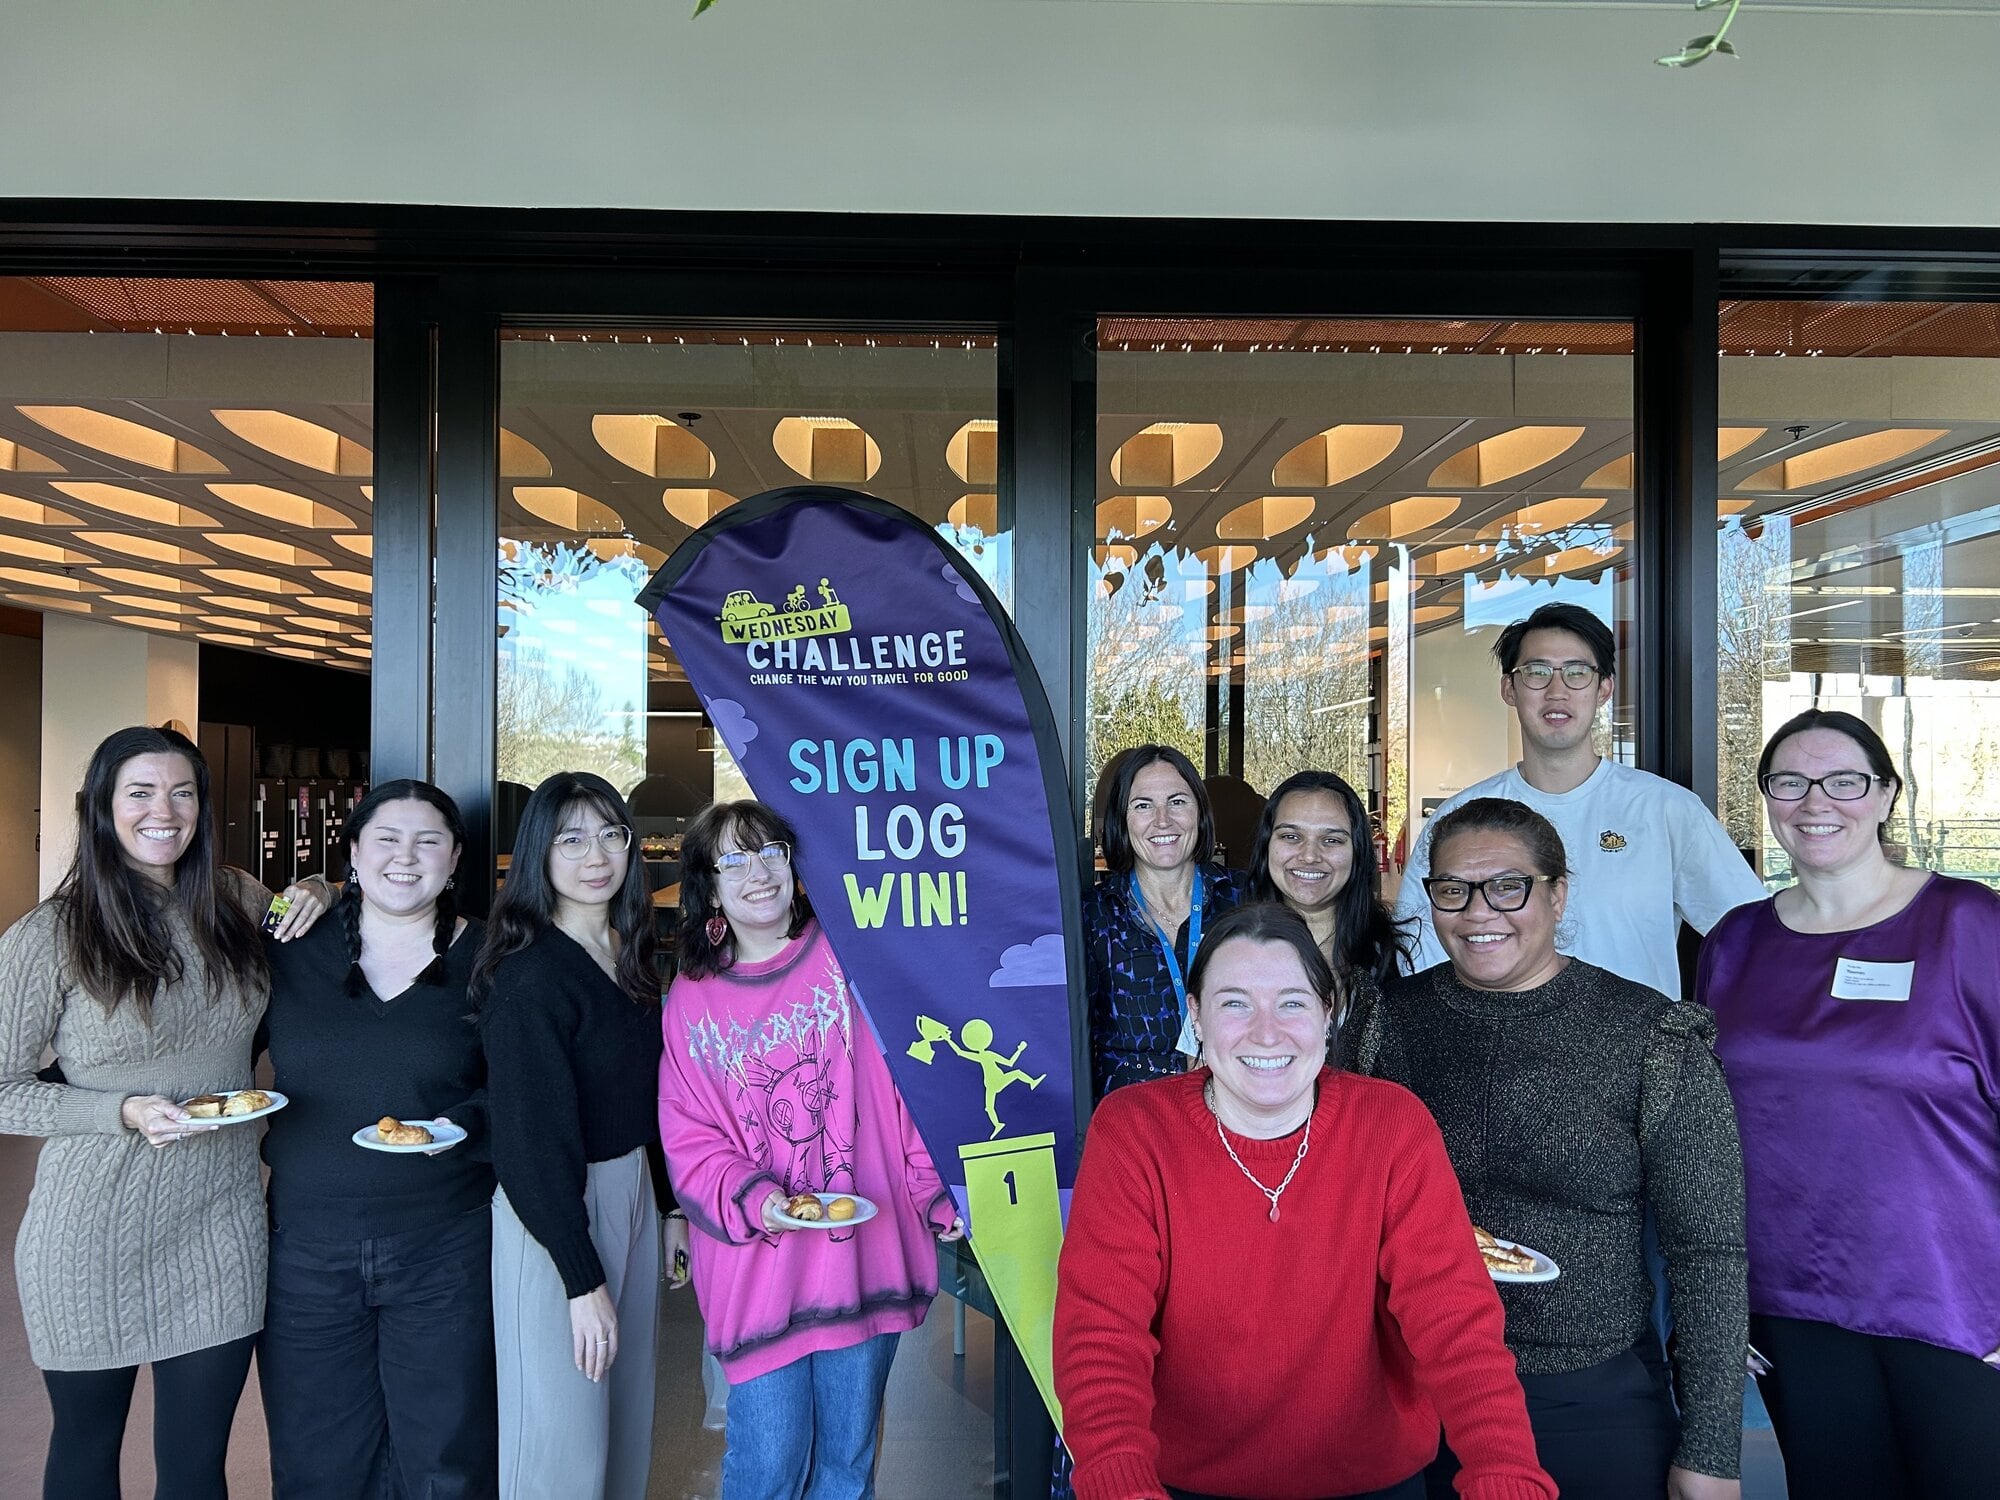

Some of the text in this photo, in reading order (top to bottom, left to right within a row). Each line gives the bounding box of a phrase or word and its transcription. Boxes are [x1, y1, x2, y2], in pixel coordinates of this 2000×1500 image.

[730, 610, 839, 640] WEDNESDAY
[746, 629, 967, 671] CHALLENGE
[750, 670, 969, 686] CHANGE THE WAY YOU TRAVEL FOR GOOD
[788, 734, 1005, 794] SIGN UP
[855, 802, 967, 861] LOG
[842, 870, 969, 929] WIN!
[1003, 1170, 1018, 1205] 1
